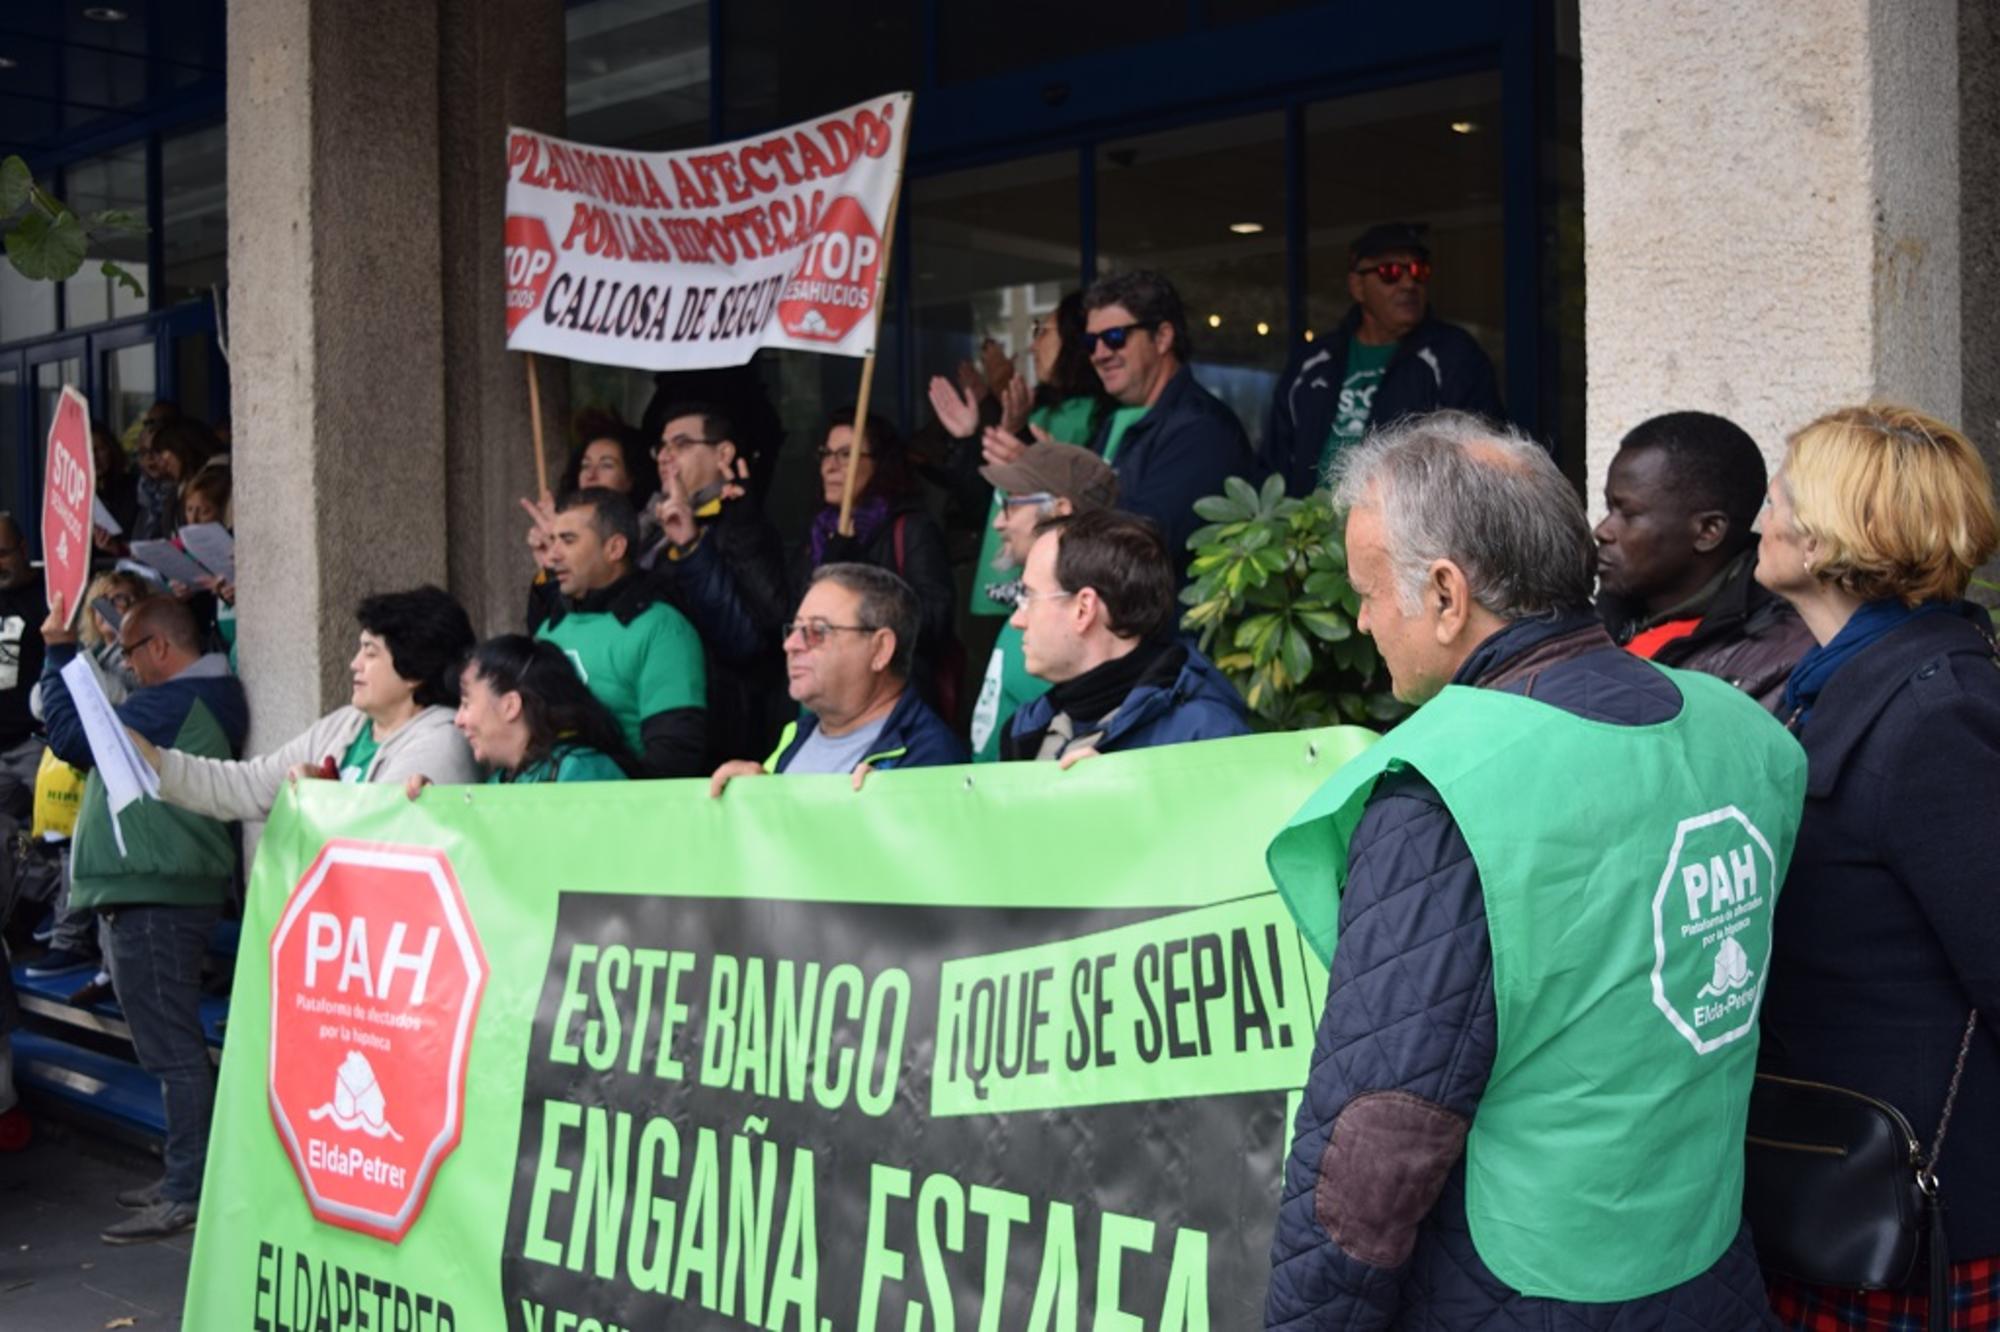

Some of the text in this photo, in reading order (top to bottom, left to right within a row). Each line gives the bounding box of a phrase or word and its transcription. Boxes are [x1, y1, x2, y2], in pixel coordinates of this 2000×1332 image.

[543, 272, 665, 343] CALLOSA
[671, 286, 716, 342] DE
[53, 440, 87, 512] STOP
[1682, 843, 1757, 921] PAH
[304, 910, 441, 1006] PAH
[296, 991, 352, 1018] Plataforma
[320, 1024, 339, 1040] por
[340, 1025, 352, 1041] la
[549, 923, 1294, 1118] ESTE BANCO ¡QUE SE SEPA!
[308, 1138, 406, 1190] EldaPetrer
